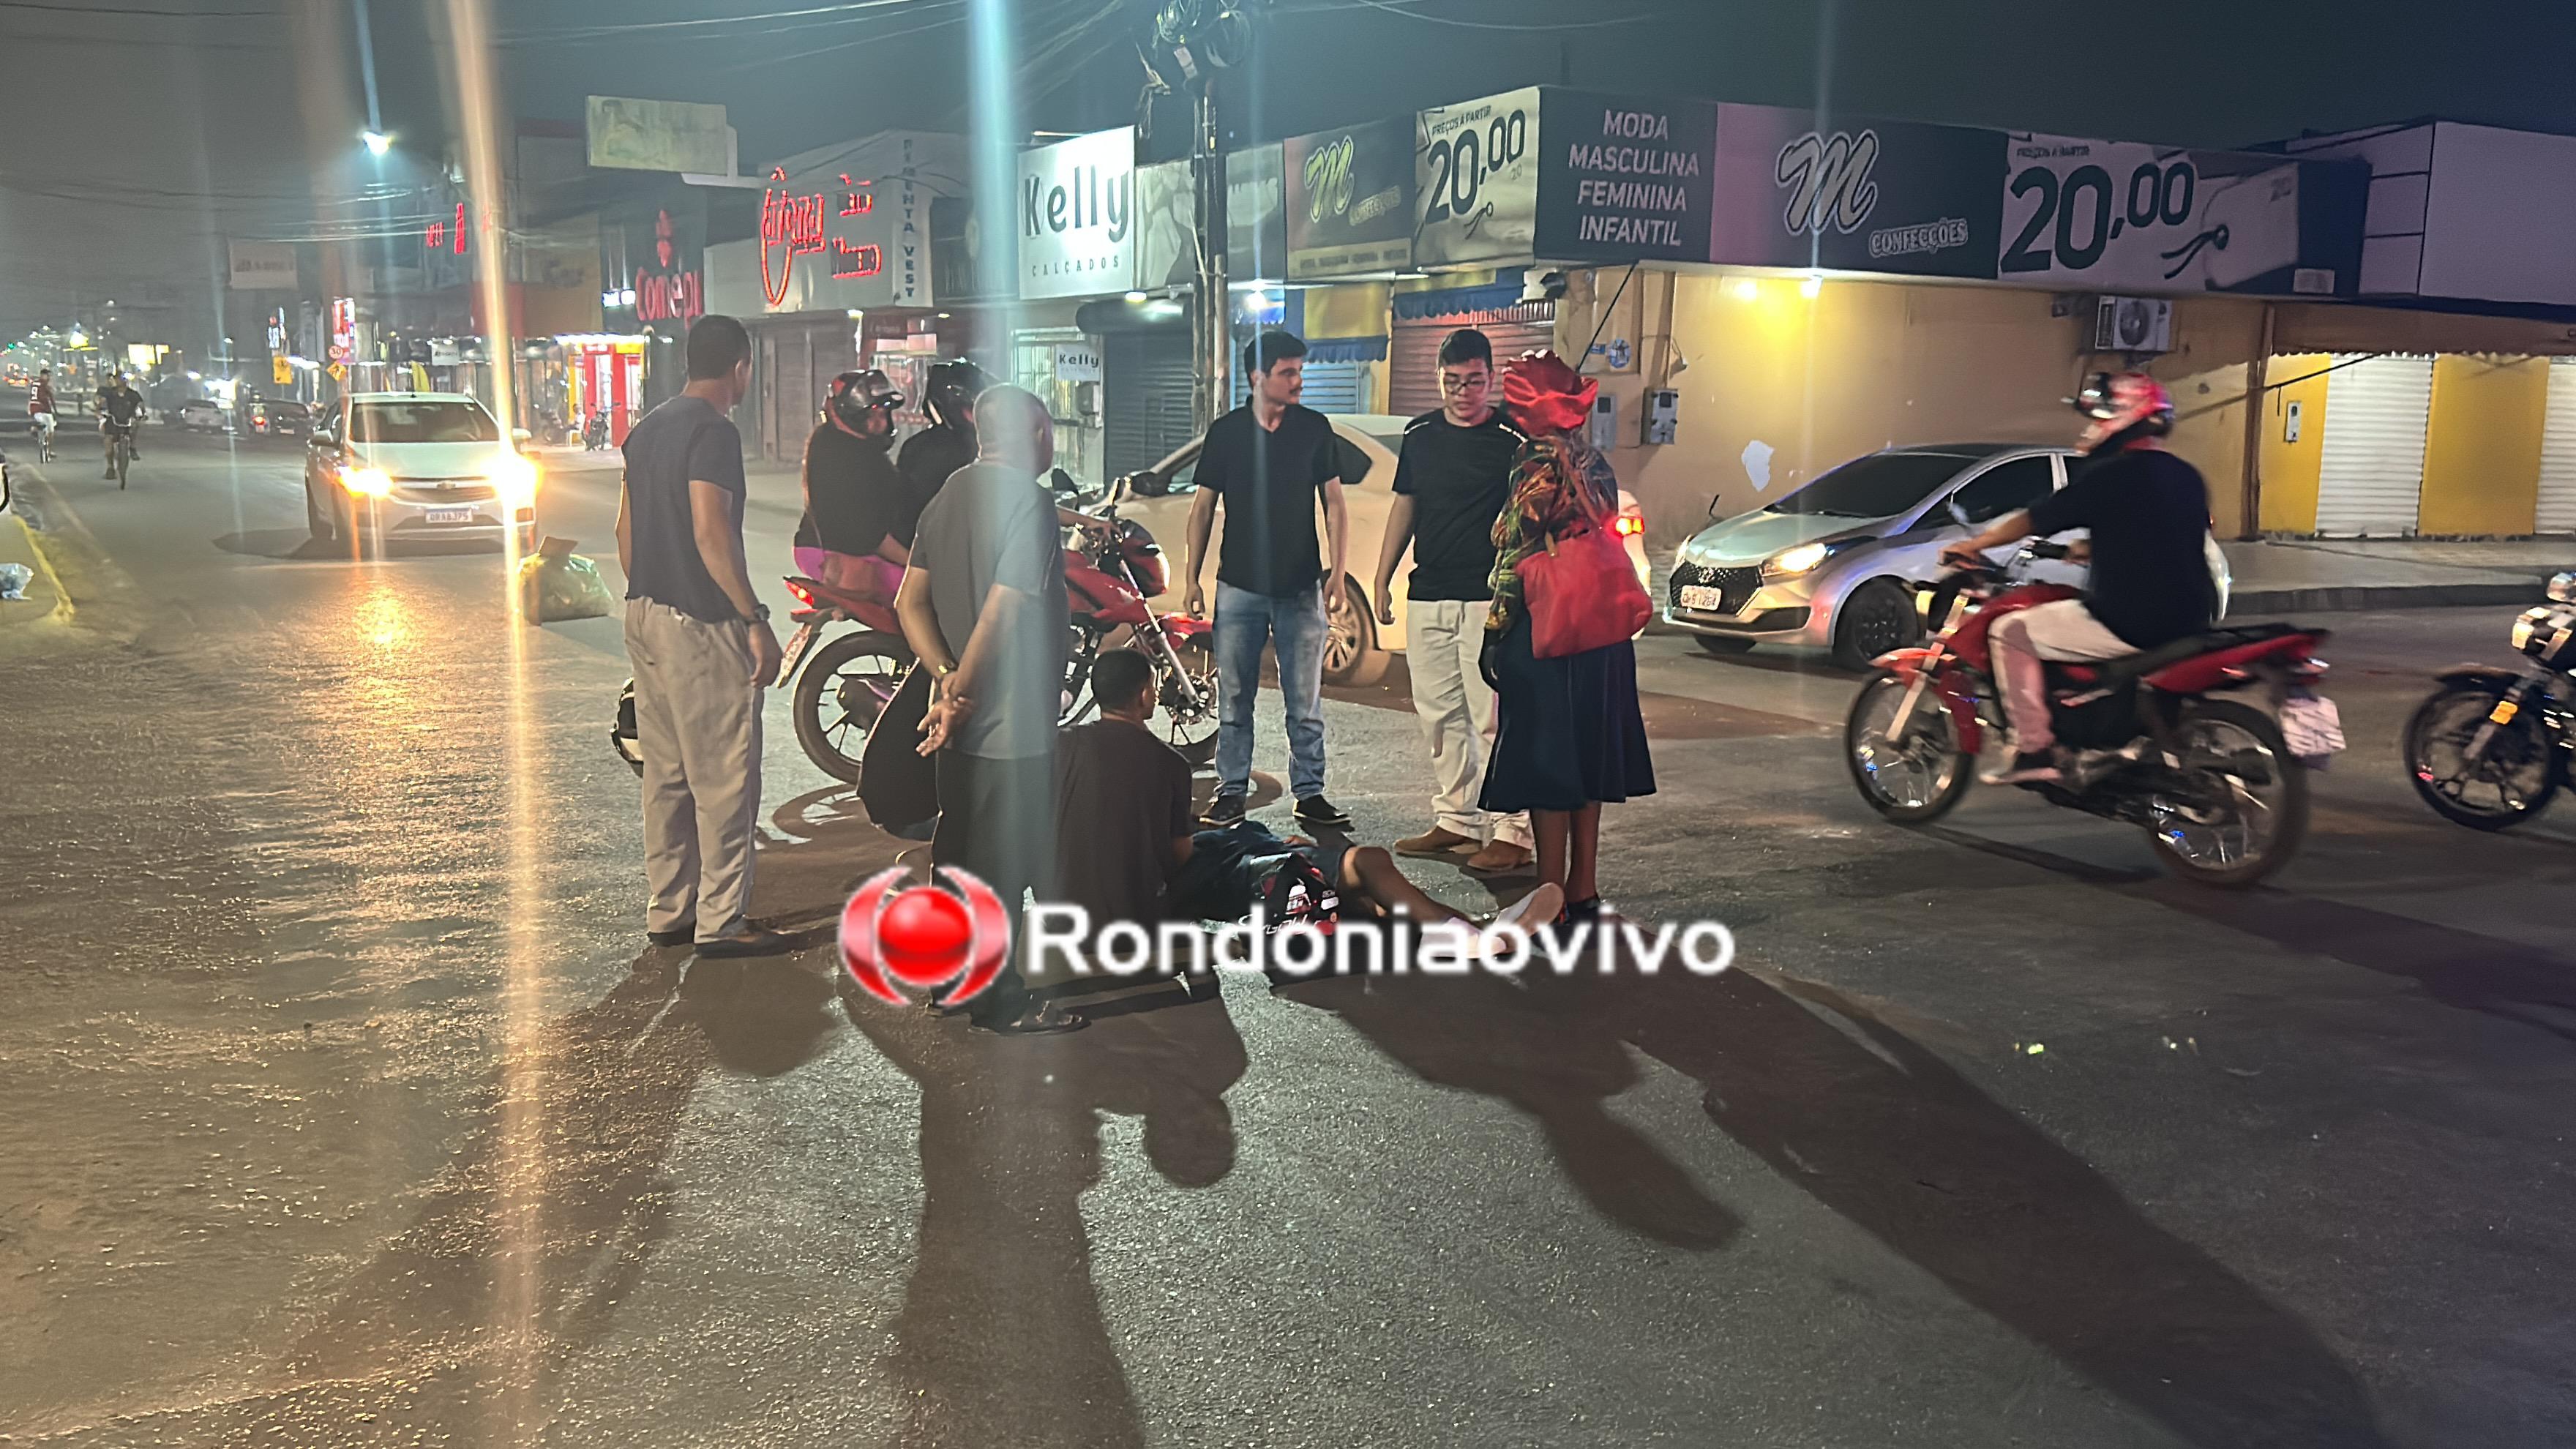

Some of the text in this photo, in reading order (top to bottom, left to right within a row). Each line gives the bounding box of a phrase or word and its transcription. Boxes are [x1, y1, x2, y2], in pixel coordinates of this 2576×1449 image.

[1465, 105, 1491, 124] PARTIR
[1603, 108, 1669, 141] MODA
[1426, 109, 1525, 224] 20,00
[1568, 143, 1699, 177] MASCULINA
[1304, 135, 1355, 223] M
[1577, 179, 1687, 211] FEMININA
[1775, 129, 1880, 236] M
[1024, 164, 1129, 244] Kelly
[2000, 162, 2195, 273] 20,00
[1579, 214, 1682, 247] INFANTIL
[1871, 218, 1968, 257] CONFECÇÕES
[902, 244, 916, 299] VEST
[1032, 255, 1119, 278] CALÇADOS
[1059, 353, 1099, 368] Kelly
